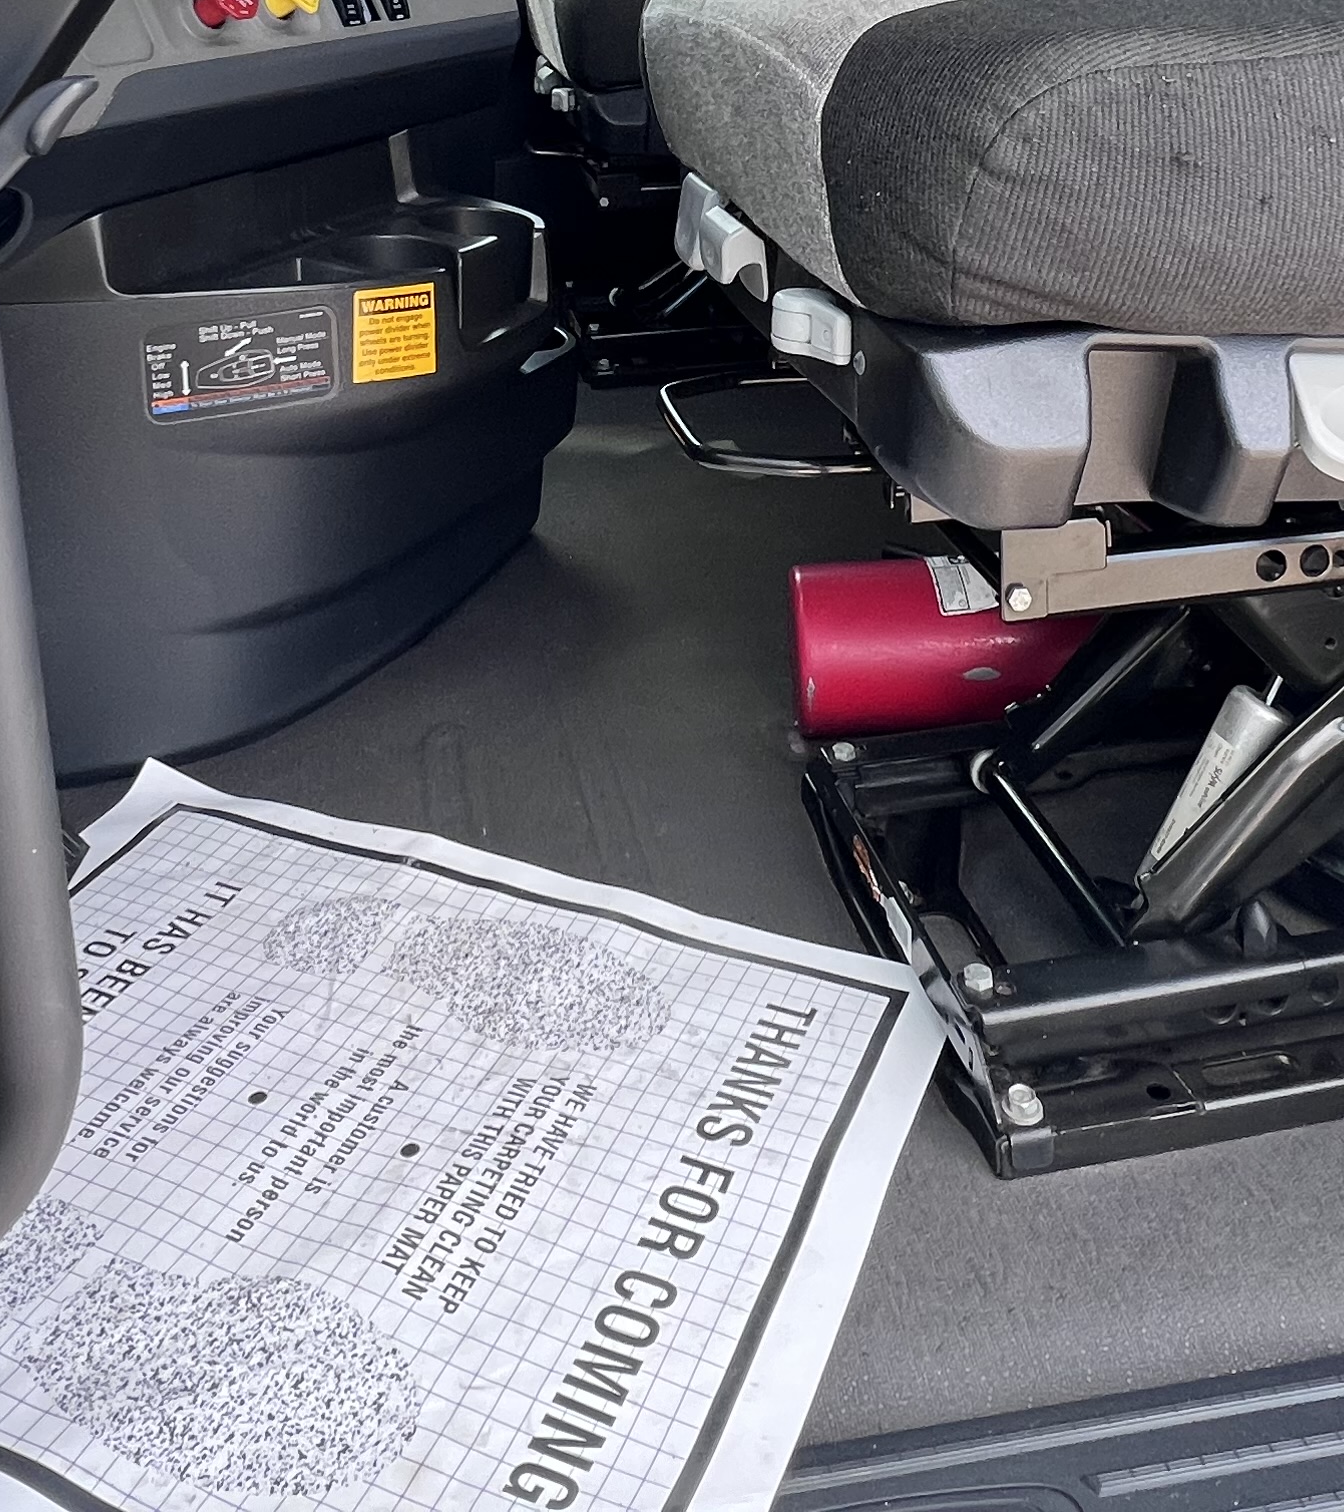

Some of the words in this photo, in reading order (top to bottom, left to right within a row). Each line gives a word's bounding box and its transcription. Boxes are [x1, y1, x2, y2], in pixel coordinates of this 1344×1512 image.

[361, 294, 429, 313] WARNING
[204, 881, 243, 908] IT
[83, 930, 137, 958] TO
[142, 908, 213, 955] HAS
[212, 991, 241, 1014] are
[248, 1008, 291, 1041] Your
[156, 1016, 214, 1064] always
[186, 996, 271, 1065] improving
[392, 1024, 423, 1050] the
[324, 1065, 357, 1090] the
[348, 1047, 374, 1064] in
[356, 1053, 398, 1092] most
[696, 1003, 818, 1147] THANKS
[152, 1041, 251, 1134] suggestions
[159, 1067, 191, 1095] our
[387, 1079, 409, 1092] A
[492, 1077, 537, 1119] WITH
[523, 1076, 571, 1120] YOUR
[565, 1083, 598, 1113] WE
[70, 1066, 159, 1143] welcome.
[280, 1091, 329, 1138] world
[93, 1096, 161, 1159] service
[125, 1136, 159, 1163] for
[261, 1139, 288, 1158] to
[283, 1093, 366, 1176] important
[323, 1095, 394, 1174] customer
[460, 1125, 504, 1161] THIS
[532, 1113, 578, 1161] HAVE
[231, 1161, 266, 1187] us.
[304, 1176, 332, 1195] is
[413, 1163, 472, 1224] PAPER
[451, 1123, 535, 1228] CARPETING
[495, 1162, 546, 1221] TRIED
[225, 1175, 289, 1243] person
[636, 1155, 735, 1260] FOR
[380, 1227, 426, 1276] MAT
[474, 1227, 507, 1254] TO
[401, 1229, 462, 1301] CLEAN
[438, 1257, 486, 1314] KEEP
[502, 1269, 678, 1512] COMING
